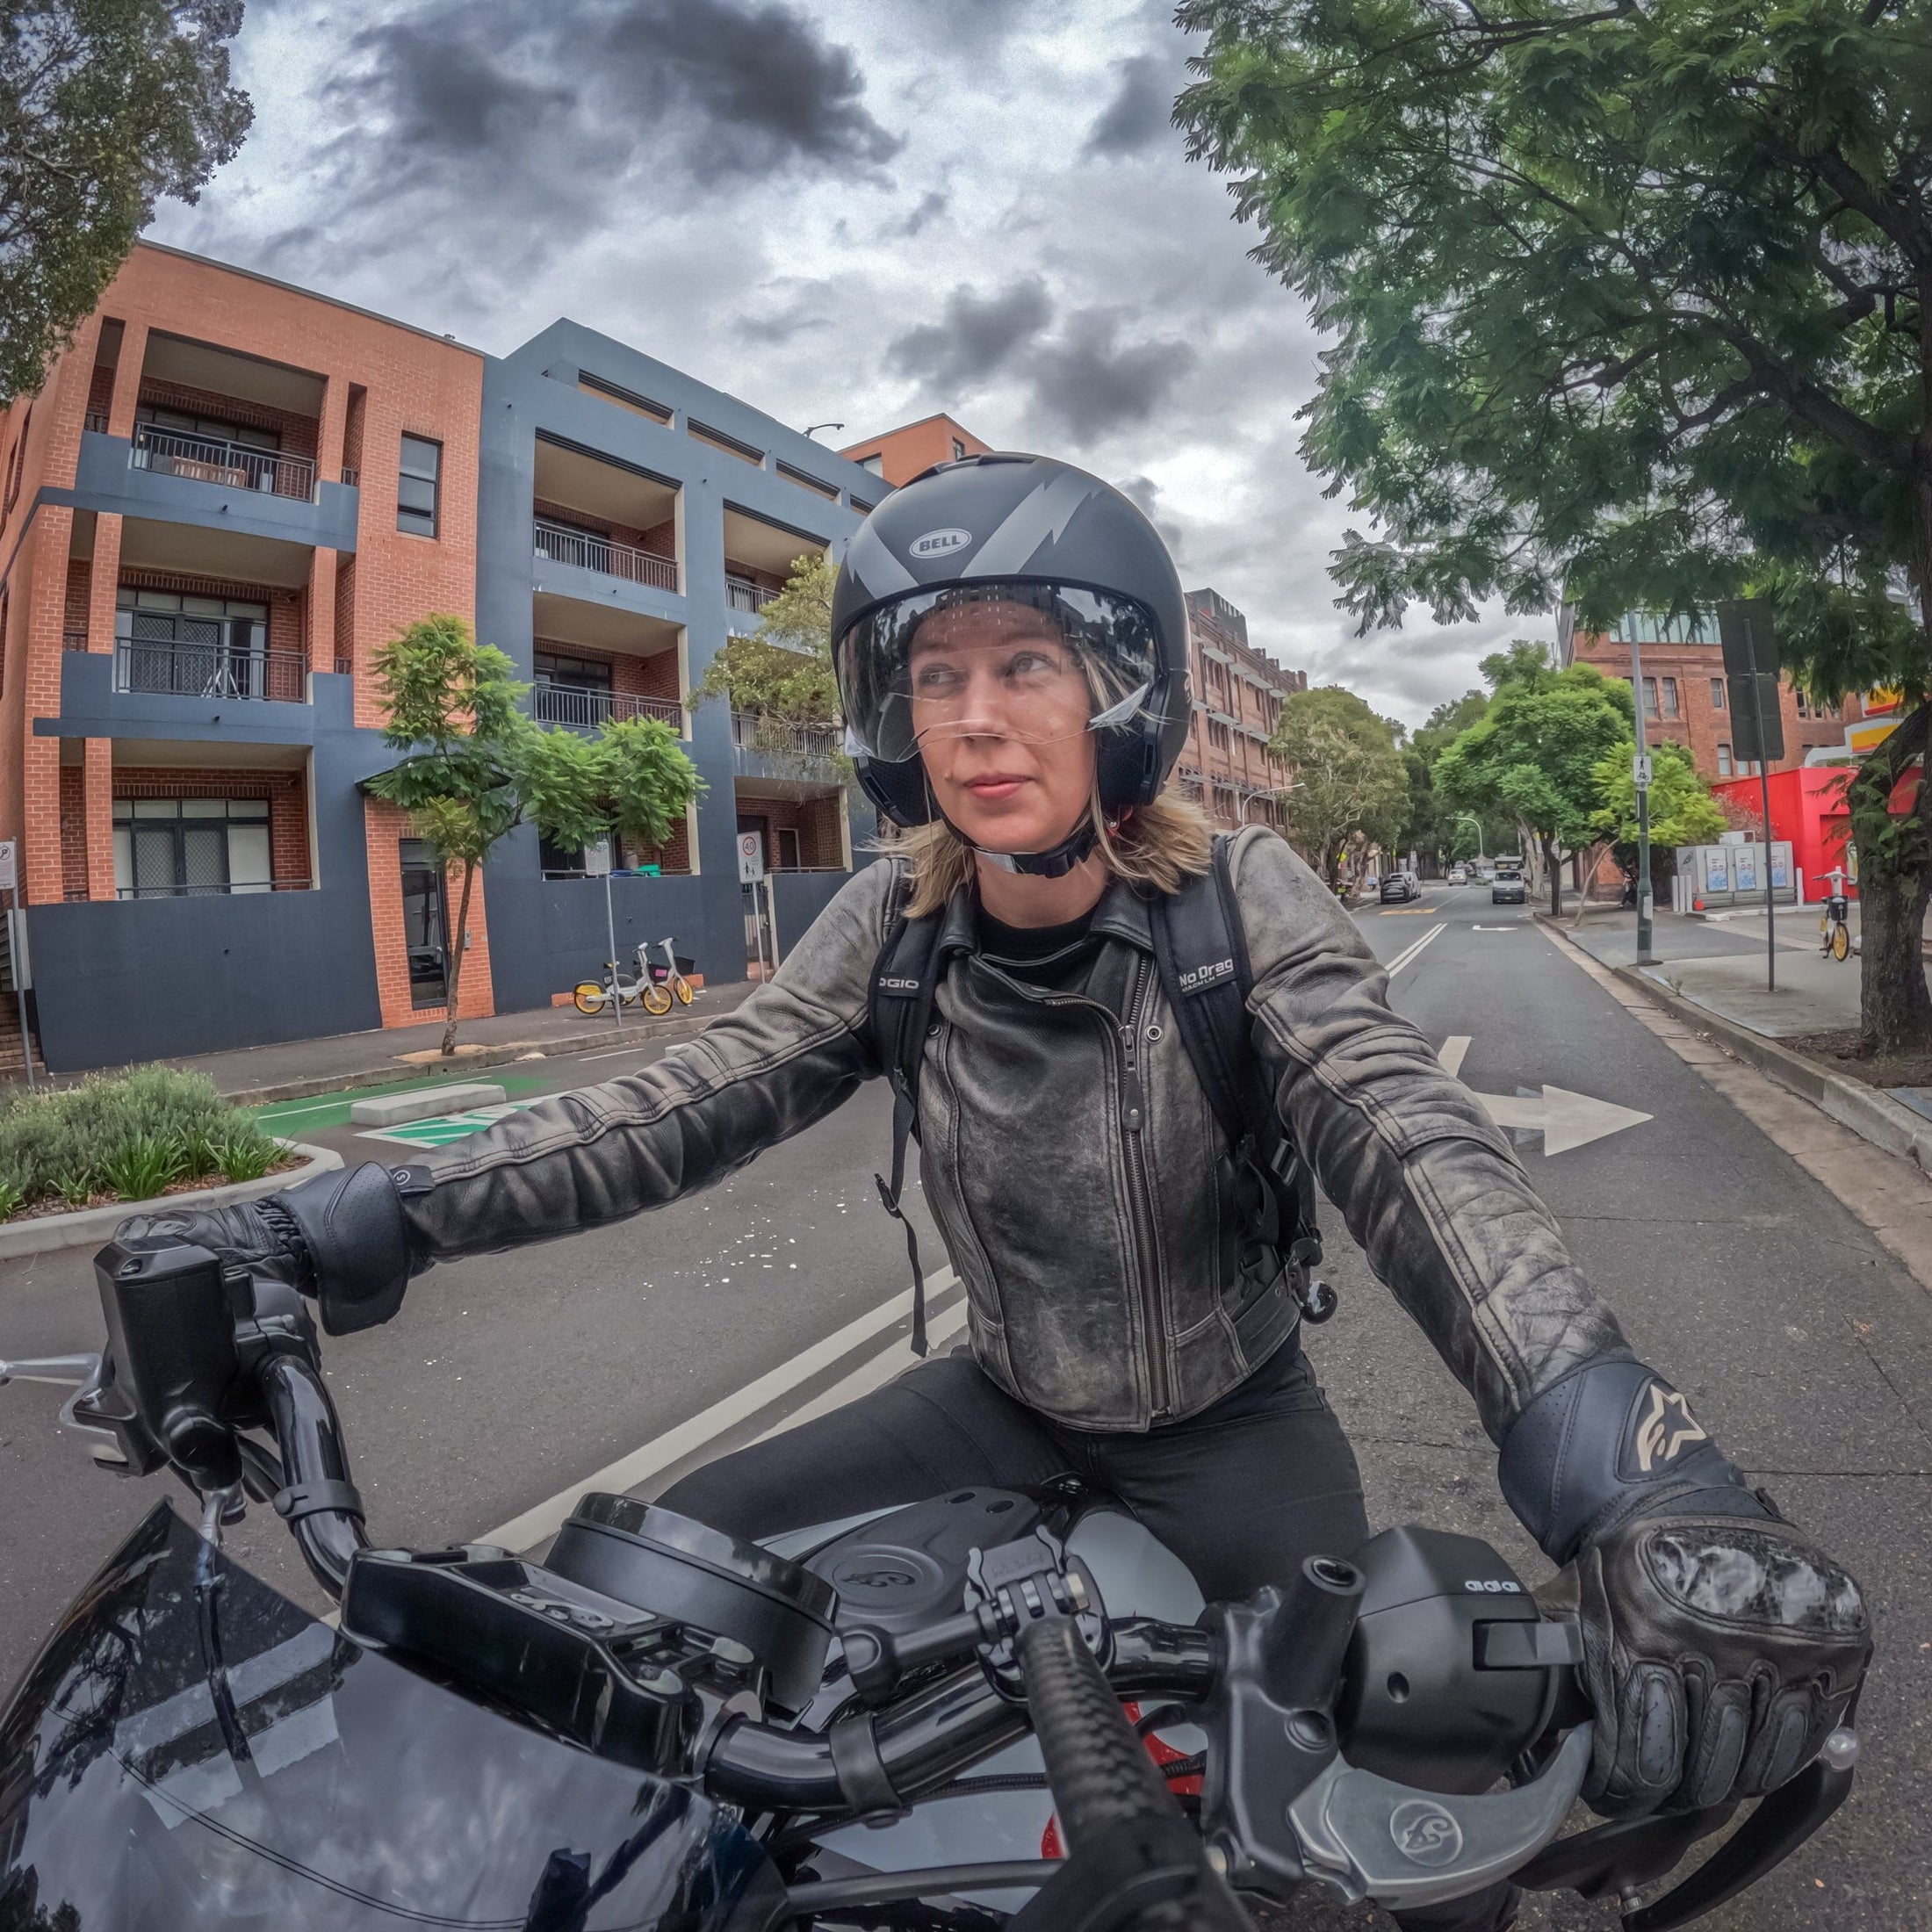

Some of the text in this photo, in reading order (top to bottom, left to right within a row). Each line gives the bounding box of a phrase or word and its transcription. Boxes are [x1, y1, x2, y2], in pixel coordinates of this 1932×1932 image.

[919, 535, 962, 552] BELL
[745, 840, 754, 851] 40
[1179, 958, 1234, 987] No Drag
